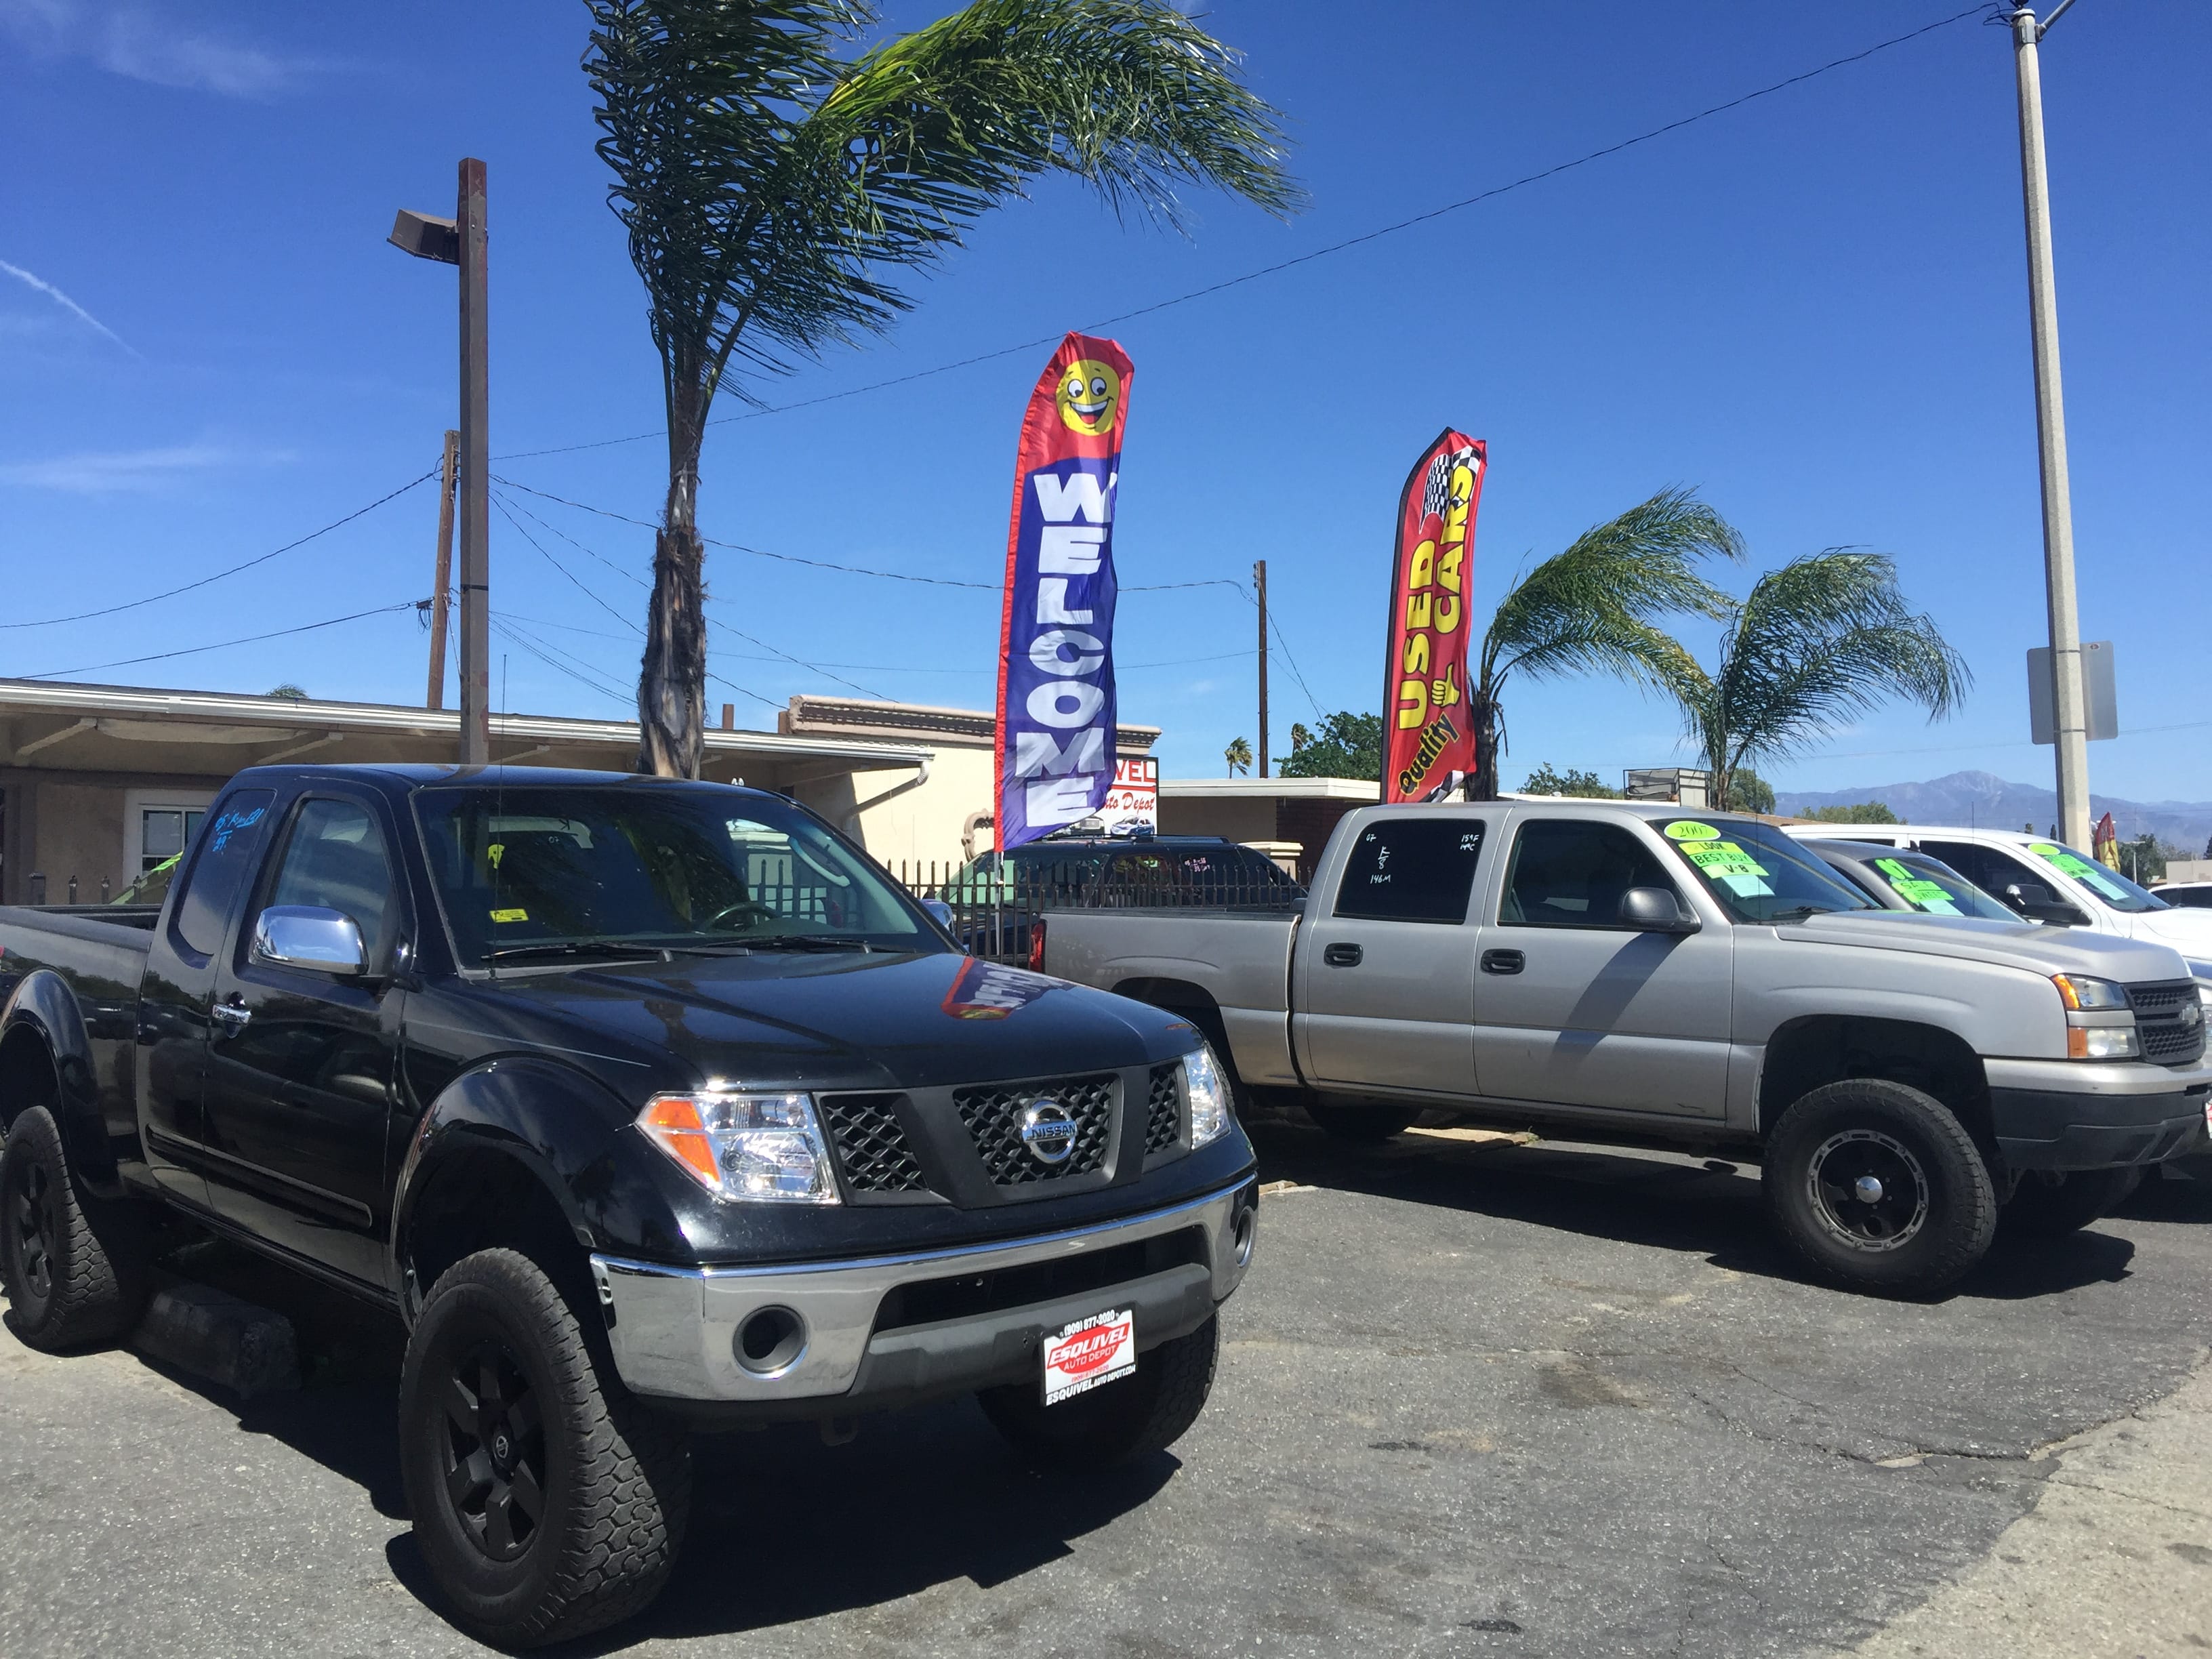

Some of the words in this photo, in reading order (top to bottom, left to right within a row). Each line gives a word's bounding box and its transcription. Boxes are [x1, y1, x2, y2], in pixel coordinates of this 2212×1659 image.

[1433, 465, 1474, 635] CARS
[1398, 539, 1436, 730] USED
[1016, 472, 1117, 827] WELCOME
[1398, 711, 1460, 796] Quality
[1122, 792, 1155, 814] Depot
[1677, 825, 1707, 837] 2007
[1694, 853, 1725, 863] BEST
[1726, 853, 1748, 861] BUY
[1031, 1124, 1076, 1139] NISSAN
[1064, 1319, 1083, 1336] (909)
[1048, 1328, 1128, 1364] ESQUIVEL
[1064, 1355, 1086, 1370] AUTO
[1088, 1345, 1116, 1362] DEPOT
[1046, 1378, 1094, 1406] ESQUIVEL
[1093, 1375, 1107, 1387] AUTO
